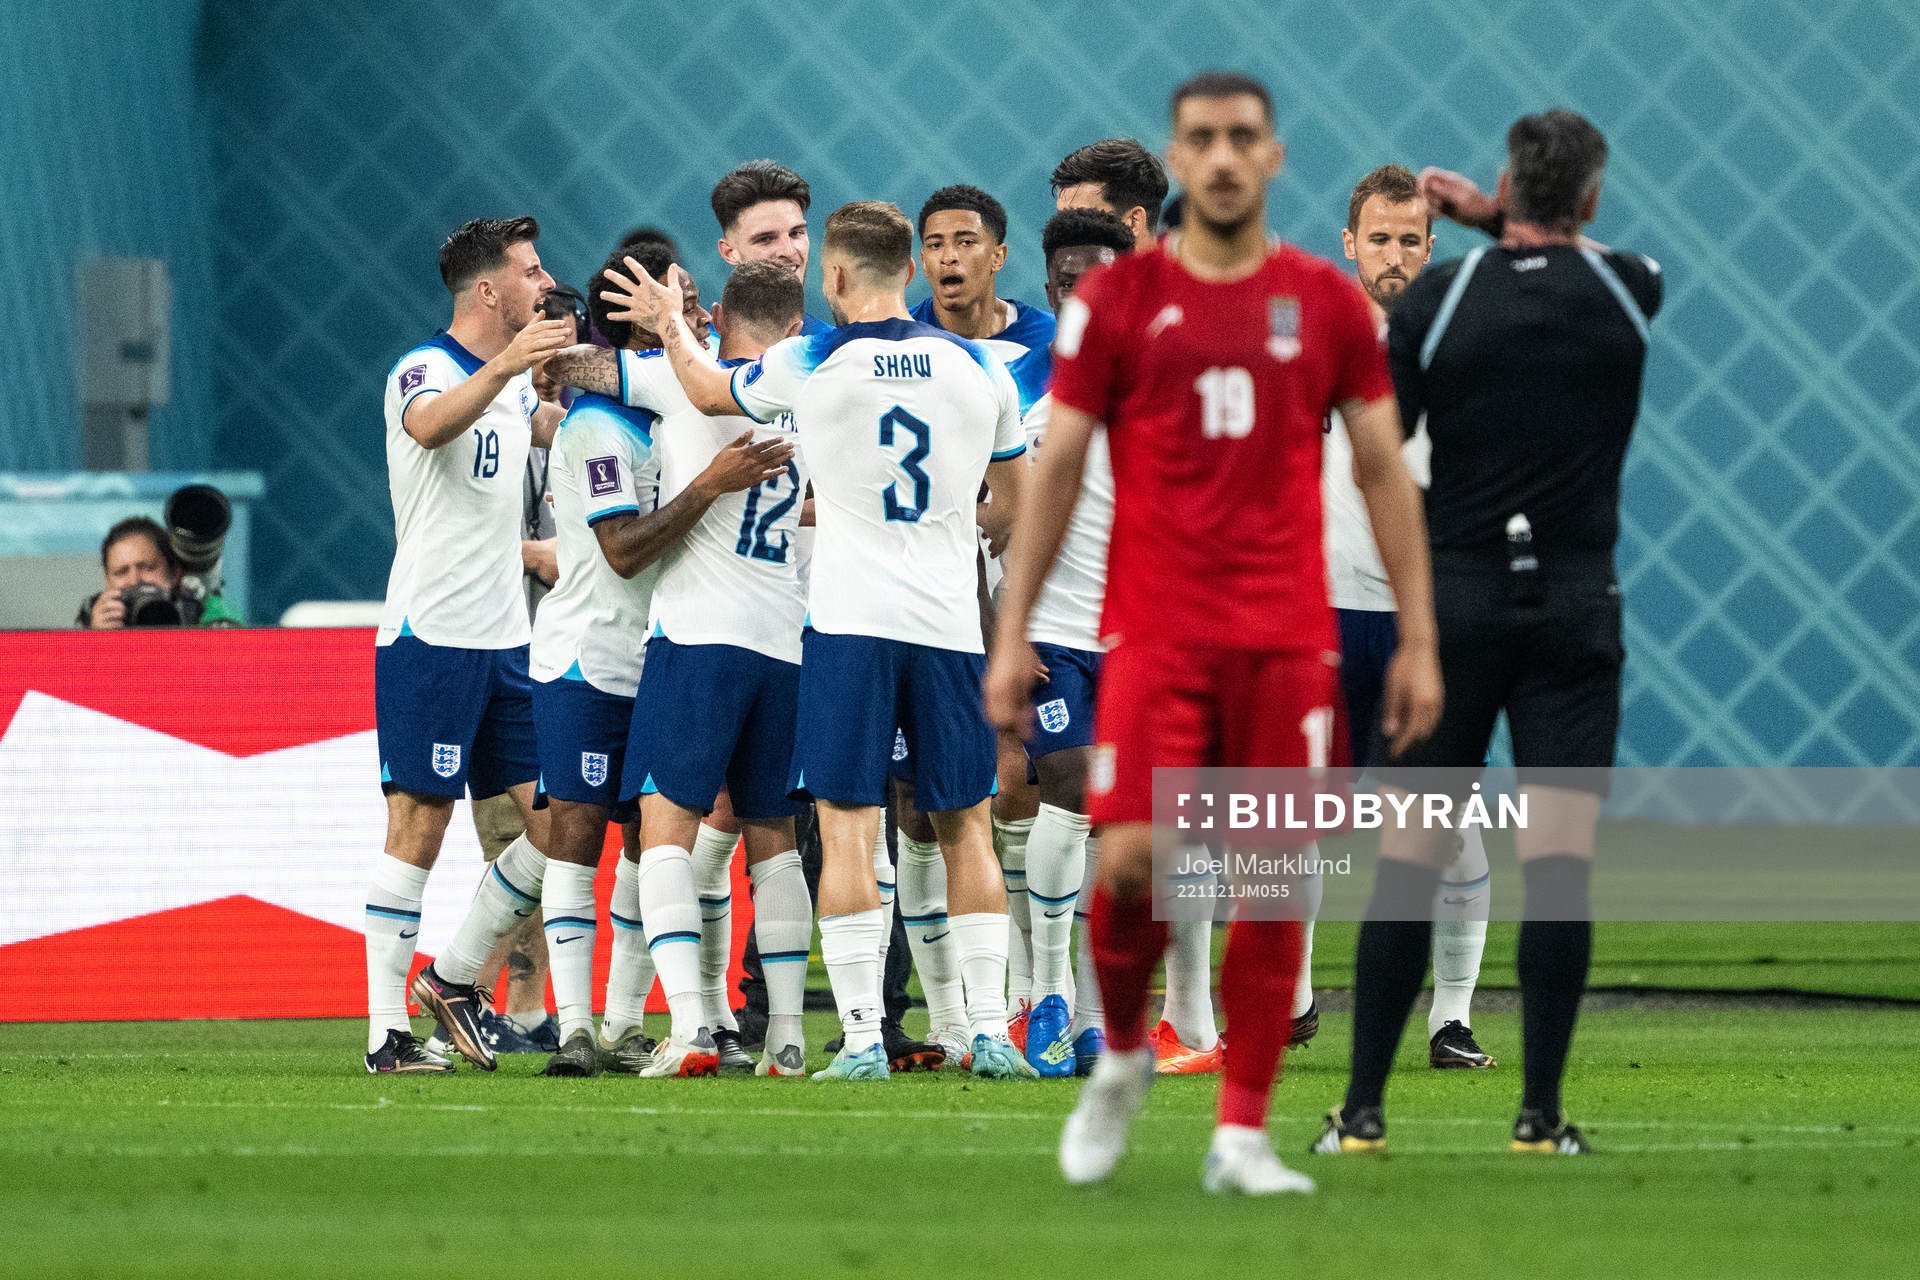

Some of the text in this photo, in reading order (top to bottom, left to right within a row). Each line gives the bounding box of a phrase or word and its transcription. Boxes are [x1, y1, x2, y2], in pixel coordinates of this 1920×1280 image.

[873, 354, 932, 377] SHAW
[1193, 366, 1255, 440] 19
[474, 428, 500, 479] 19
[878, 403, 931, 523] 3
[734, 441, 801, 564] 12
[1300, 706, 1334, 779] 1
